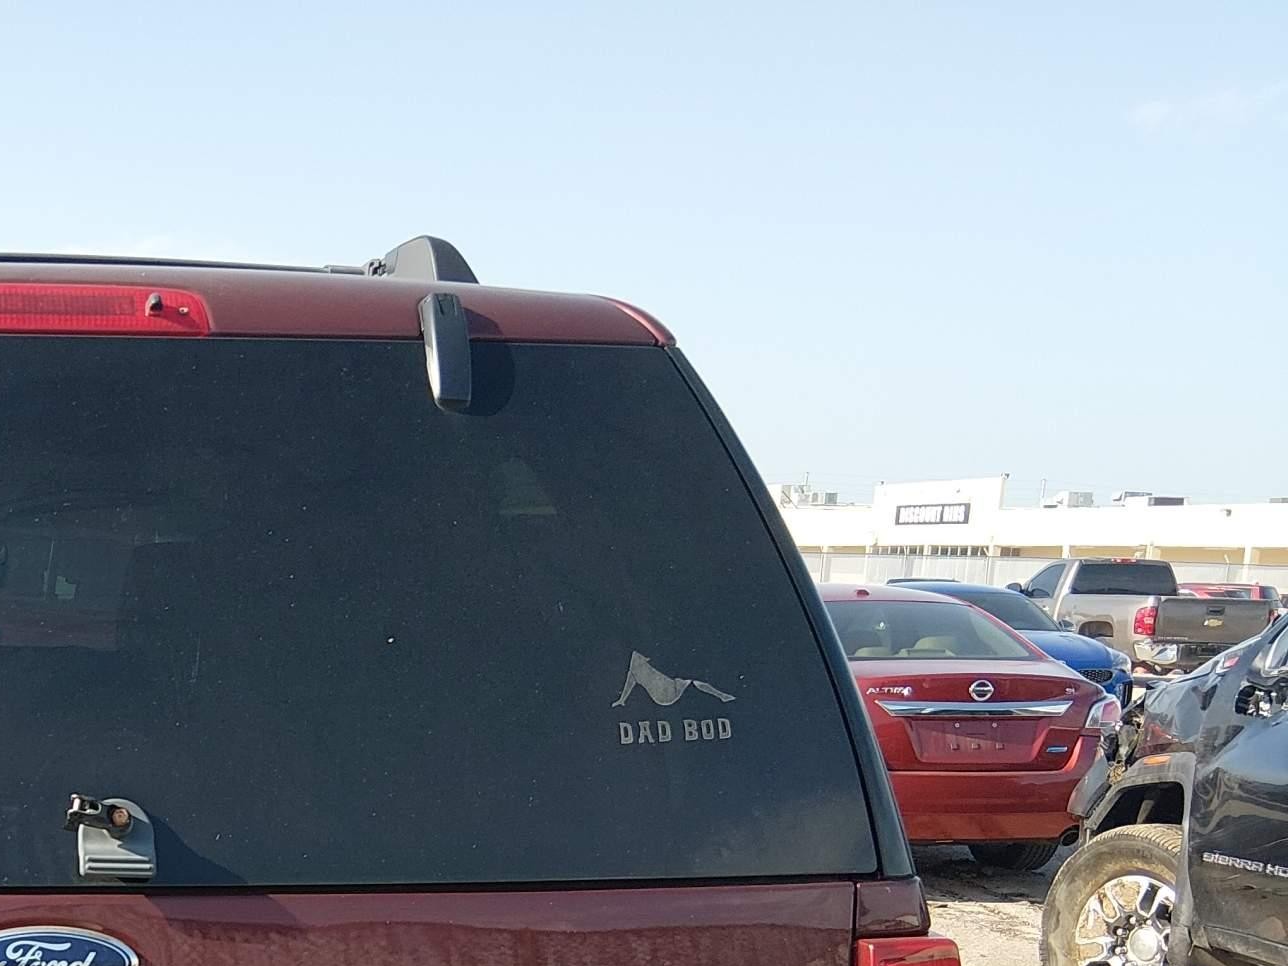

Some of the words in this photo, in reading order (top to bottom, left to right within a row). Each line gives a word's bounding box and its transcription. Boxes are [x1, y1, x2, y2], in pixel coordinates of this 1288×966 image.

[619, 721, 672, 745] DAD
[683, 718, 732, 741] BOD
[1202, 851, 1265, 872] SIERRA
